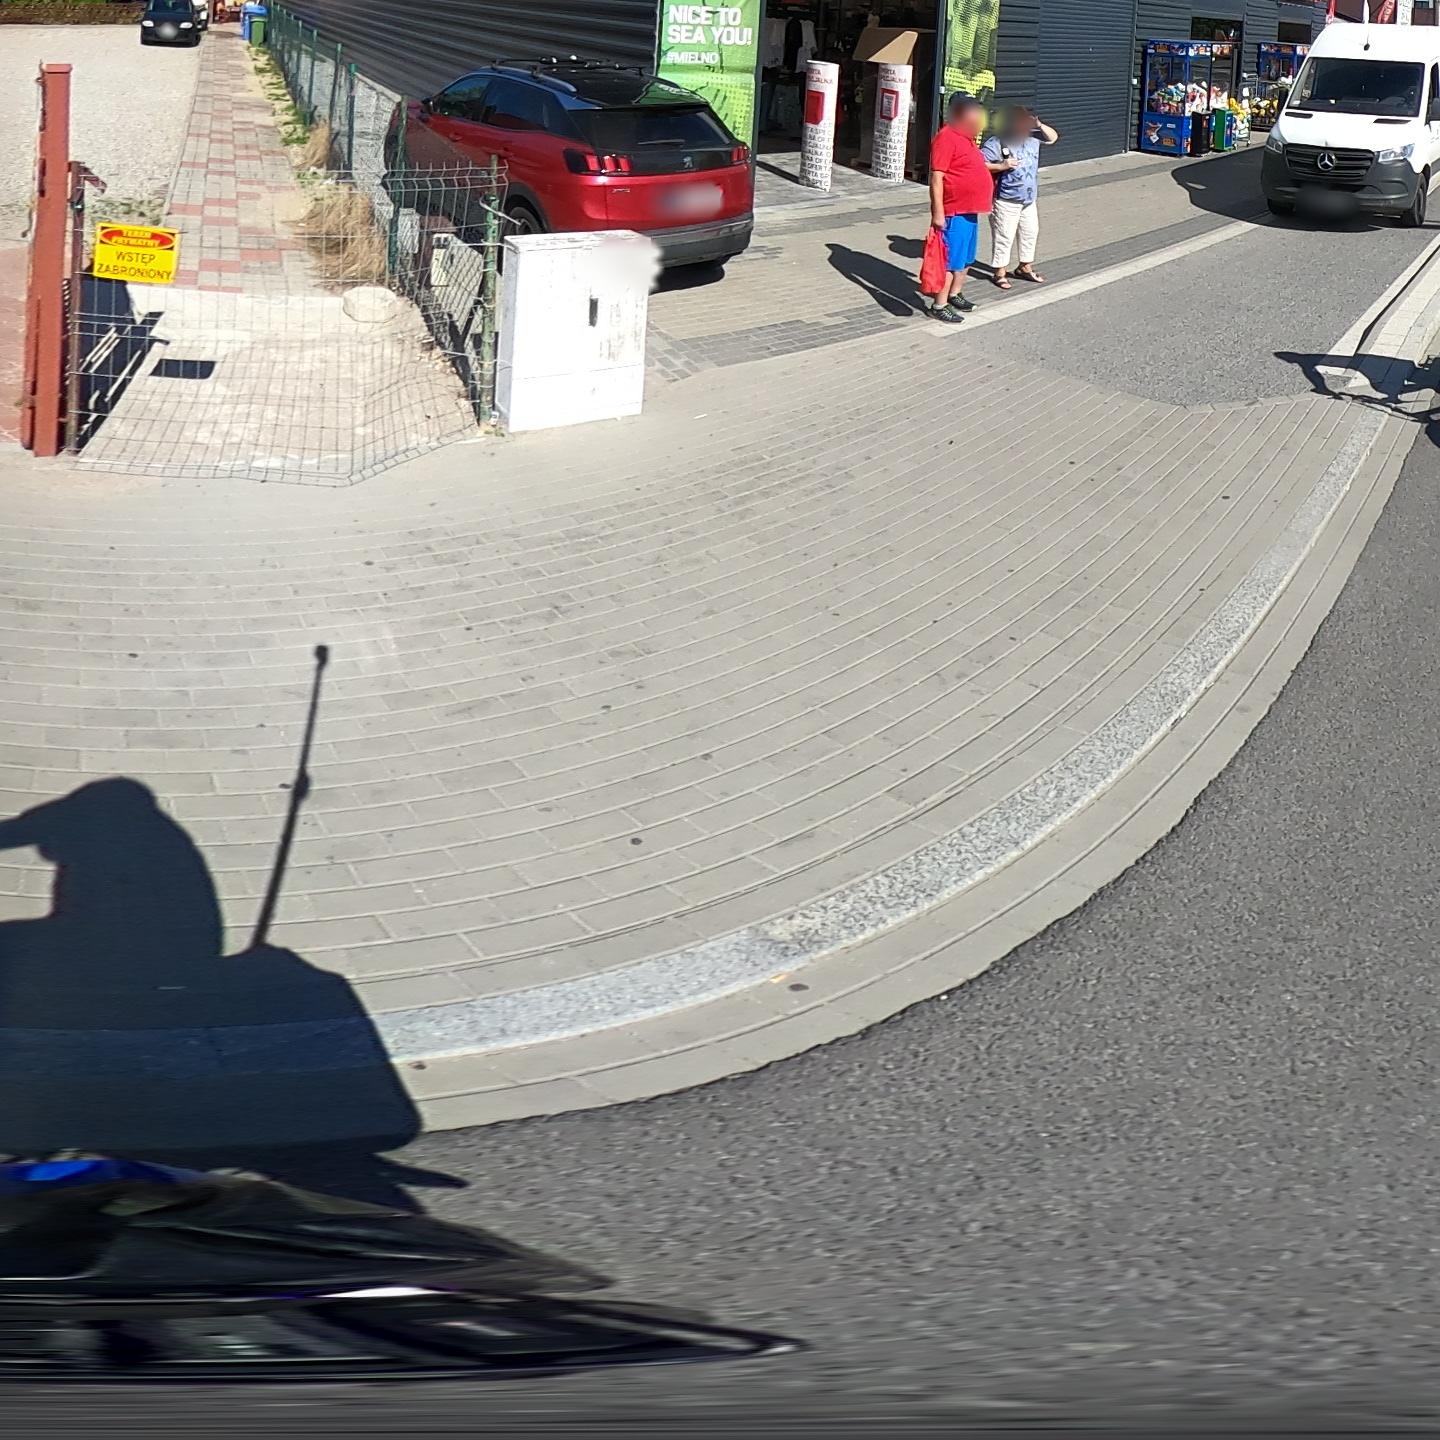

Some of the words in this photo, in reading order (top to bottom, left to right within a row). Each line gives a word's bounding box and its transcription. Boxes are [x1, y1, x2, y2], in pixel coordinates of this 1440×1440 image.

[668, 5, 713, 25] NICE
[718, 7, 742, 26] TO
[667, 24, 707, 44] SEA
[711, 26, 753, 46] YOU!
[116, 250, 156, 266] WSTĘP
[97, 263, 172, 281] ZABRONIONY
